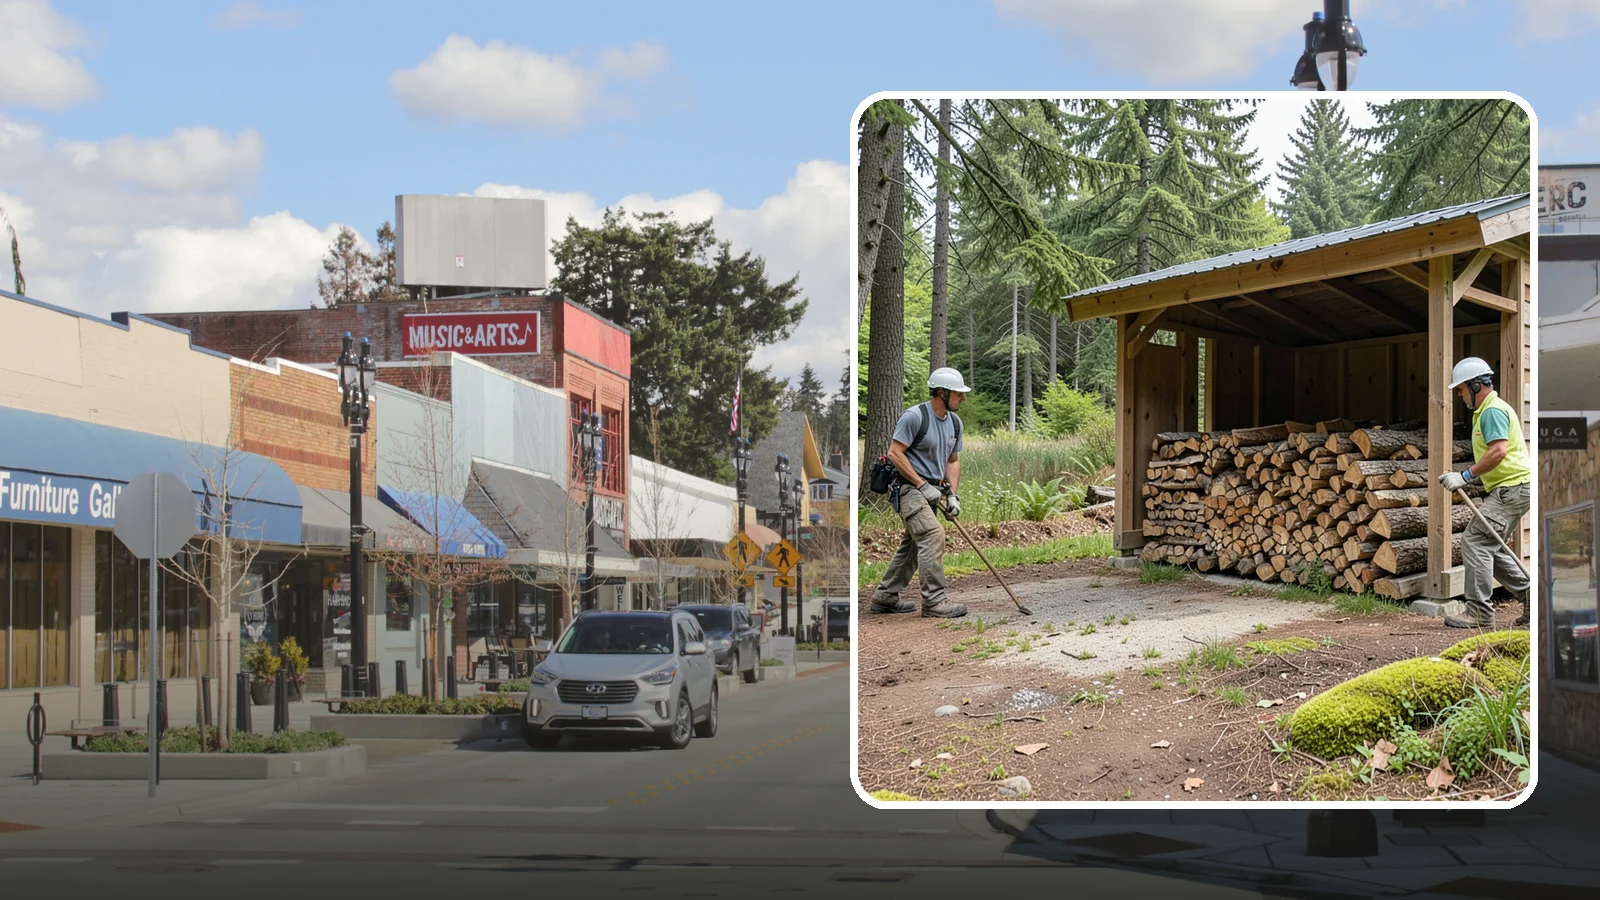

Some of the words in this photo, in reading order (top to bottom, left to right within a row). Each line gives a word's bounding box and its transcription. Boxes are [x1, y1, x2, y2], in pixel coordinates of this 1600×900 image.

[409, 323, 520, 349] MUSIC&ARTS
[0, 471, 79, 515] Furniture
[89, 482, 122, 519] Gal
